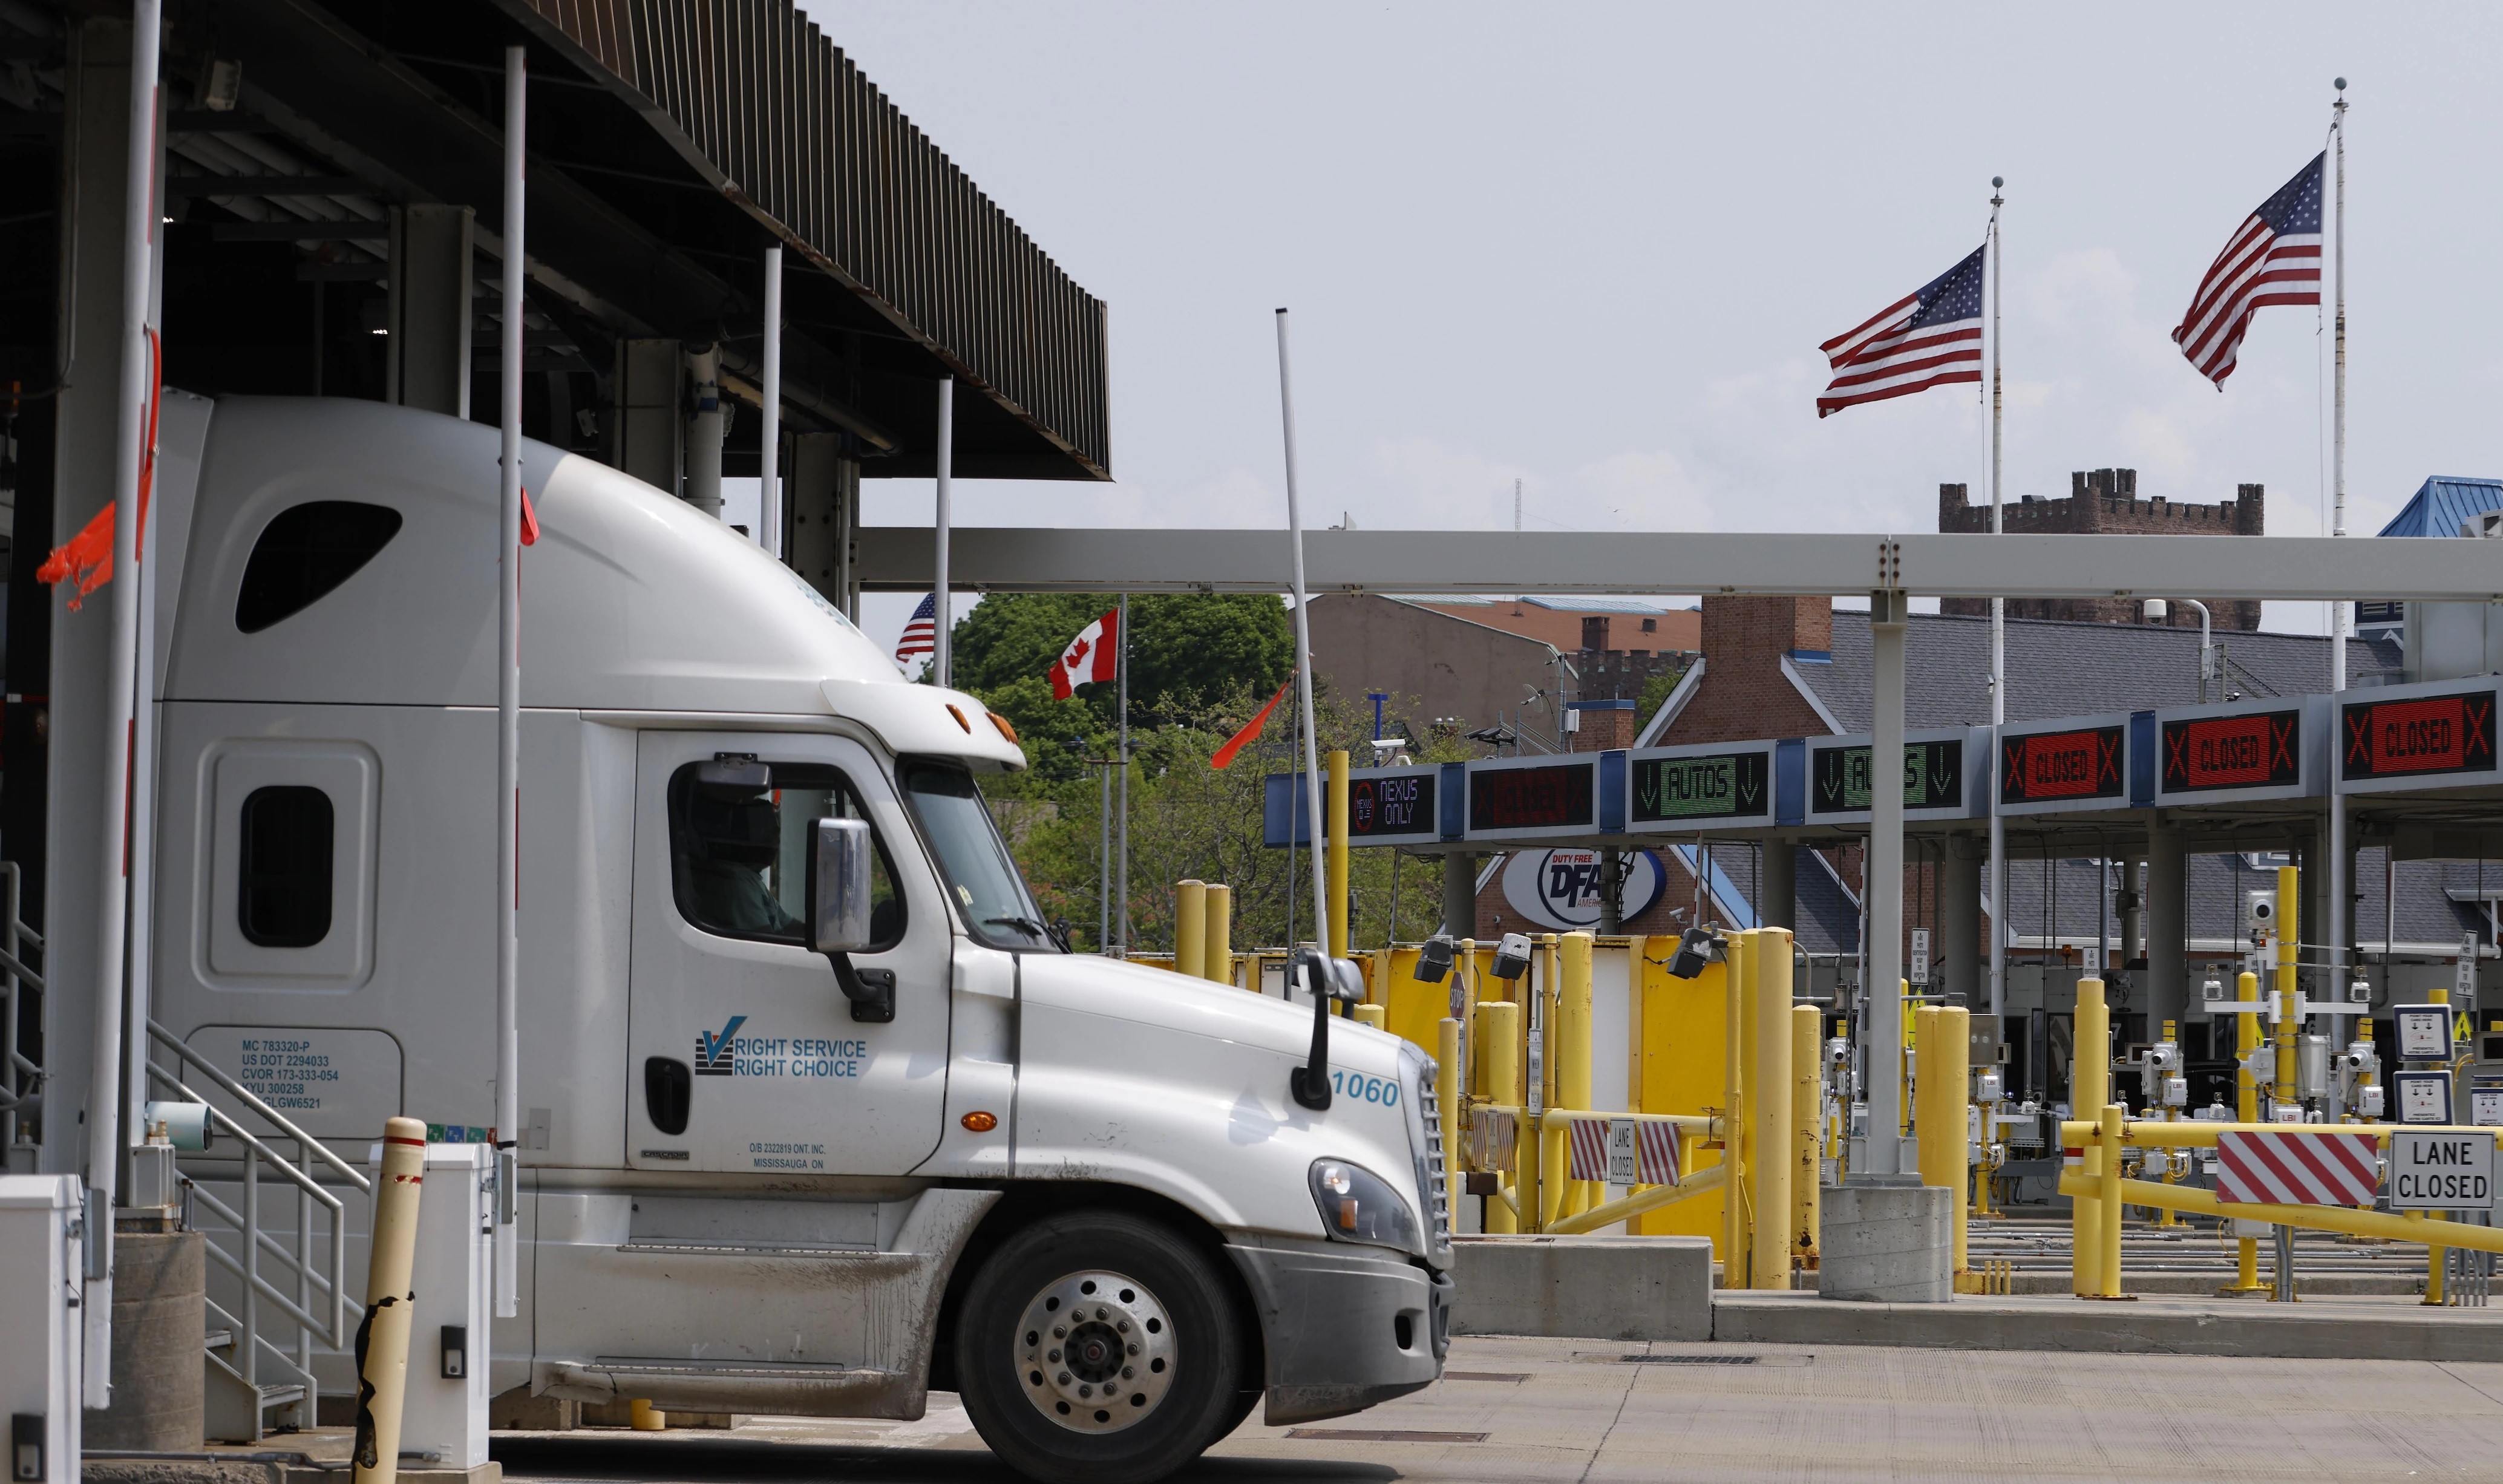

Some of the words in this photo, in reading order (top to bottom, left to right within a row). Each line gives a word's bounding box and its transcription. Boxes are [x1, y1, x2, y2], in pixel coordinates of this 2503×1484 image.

[2386, 718, 2450, 757] CLOSED
[2201, 735, 2259, 771] CLOSED
[2037, 750, 2087, 783] CLOSED
[1380, 779, 1418, 802] NEXUS
[1669, 765, 1727, 800] AUTOS
[1386, 803, 1413, 825] ONLY
[1553, 854, 1573, 863] DUTY
[1574, 854, 1593, 863] FREE
[1550, 865, 1602, 907] DFA
[1450, 988, 1464, 1008] STOP
[2111, 1023, 2121, 1040] 7
[243, 1041, 259, 1051] MC
[263, 1041, 310, 1051] 783320-P
[735, 1038, 787, 1056] RIGHT
[793, 1040, 866, 1057] SERVICE
[243, 1054, 257, 1065] US
[261, 1054, 283, 1065] DOT
[287, 1055, 329, 1067] 2294033
[735, 1059, 787, 1076] RIGHT
[791, 1060, 857, 1077] CHOICE
[242, 1068, 273, 1079] CVOR
[278, 1070, 338, 1080] 173-333-054
[243, 1083, 264, 1093] KYU
[269, 1083, 304, 1094] 300258
[1333, 1071, 1398, 1106] 1060
[263, 1097, 320, 1108] GLGW6521
[1615, 1128, 1629, 1148] LANE
[750, 1143, 762, 1152] O/B
[764, 1143, 791, 1153] 2322819
[794, 1144, 810, 1154] ONT.
[811, 1145, 826, 1154] INC.
[2413, 1142, 2473, 1165] LANE
[754, 1158, 808, 1169] MISSISSAUGA
[812, 1160, 823, 1169] ON
[1612, 1155, 1633, 1177] CLOSED
[2399, 1174, 2487, 1198] CLOSED
